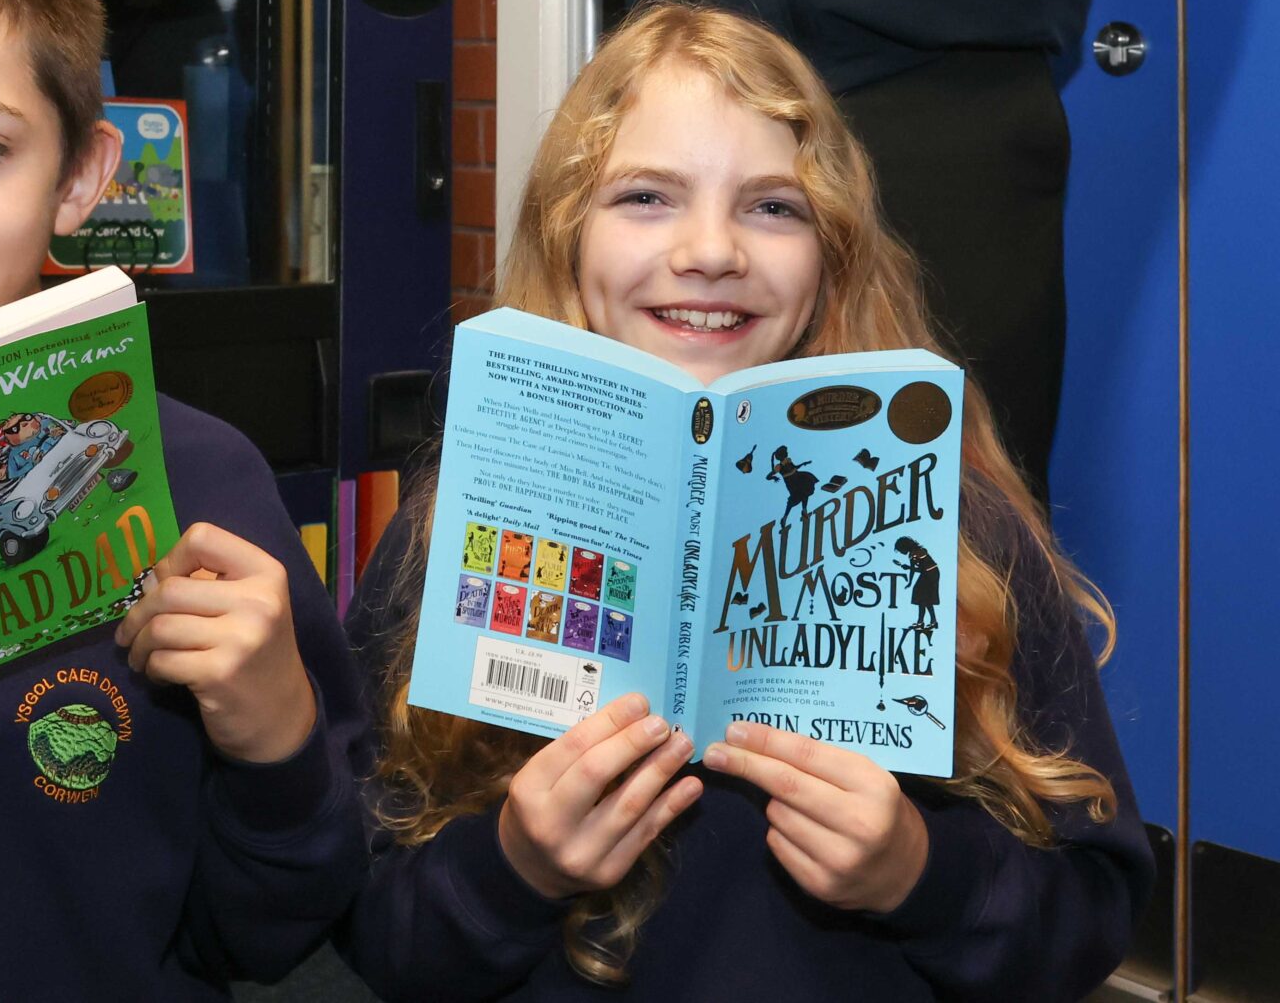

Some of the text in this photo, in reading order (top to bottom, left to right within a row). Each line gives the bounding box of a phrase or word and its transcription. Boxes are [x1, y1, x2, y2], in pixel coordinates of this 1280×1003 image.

[94, 320, 131, 336] author
[486, 361, 641, 408] BESTSELLING, AWARD-WINNING SERIES
[489, 350, 505, 360] THE
[508, 355, 531, 365] FIRST
[534, 360, 579, 377] THRILLING
[581, 373, 618, 388] MYSTERY
[631, 388, 647, 399] THE
[488, 372, 508, 381] NOW
[510, 376, 532, 388] WITH
[542, 384, 560, 394] NEW
[562, 390, 625, 413] INTRODUCTION
[627, 410, 644, 419] AND
[527, 391, 554, 403] BONUS
[556, 399, 585, 412] SHORT
[587, 407, 612, 420] STORY
[687, 455, 708, 507] MURDER
[462, 493, 532, 514] ‘Thrilling’ Guardian
[474, 511, 501, 521] delight’
[502, 517, 522, 527] Daily
[524, 521, 540, 531] Mail
[547, 512, 650, 550] ‘Ripping good fun’ The Times
[691, 510, 702, 537] MOST
[713, 452, 944, 634] MURDER
[57, 505, 157, 610] DAD
[552, 528, 642, 561] ‘Enormous fun’ Irish Times
[677, 539, 702, 613] UNLADYLIKE
[791, 564, 909, 621] MOST
[680, 621, 692, 660] ROBIN
[726, 614, 934, 682] UNLADYLIKE
[673, 661, 689, 715] STEVENS
[723, 696, 759, 705] DEEPDEAN
[762, 696, 792, 704] SCHOOL
[813, 699, 835, 707] GIRLS
[736, 678, 764, 686] THERE'S
[795, 679, 825, 687] RATHER
[14, 668, 133, 742] YSGOL CAER DREWYN
[810, 717, 913, 749] STEVENS
[34, 776, 99, 804] CORWEN
